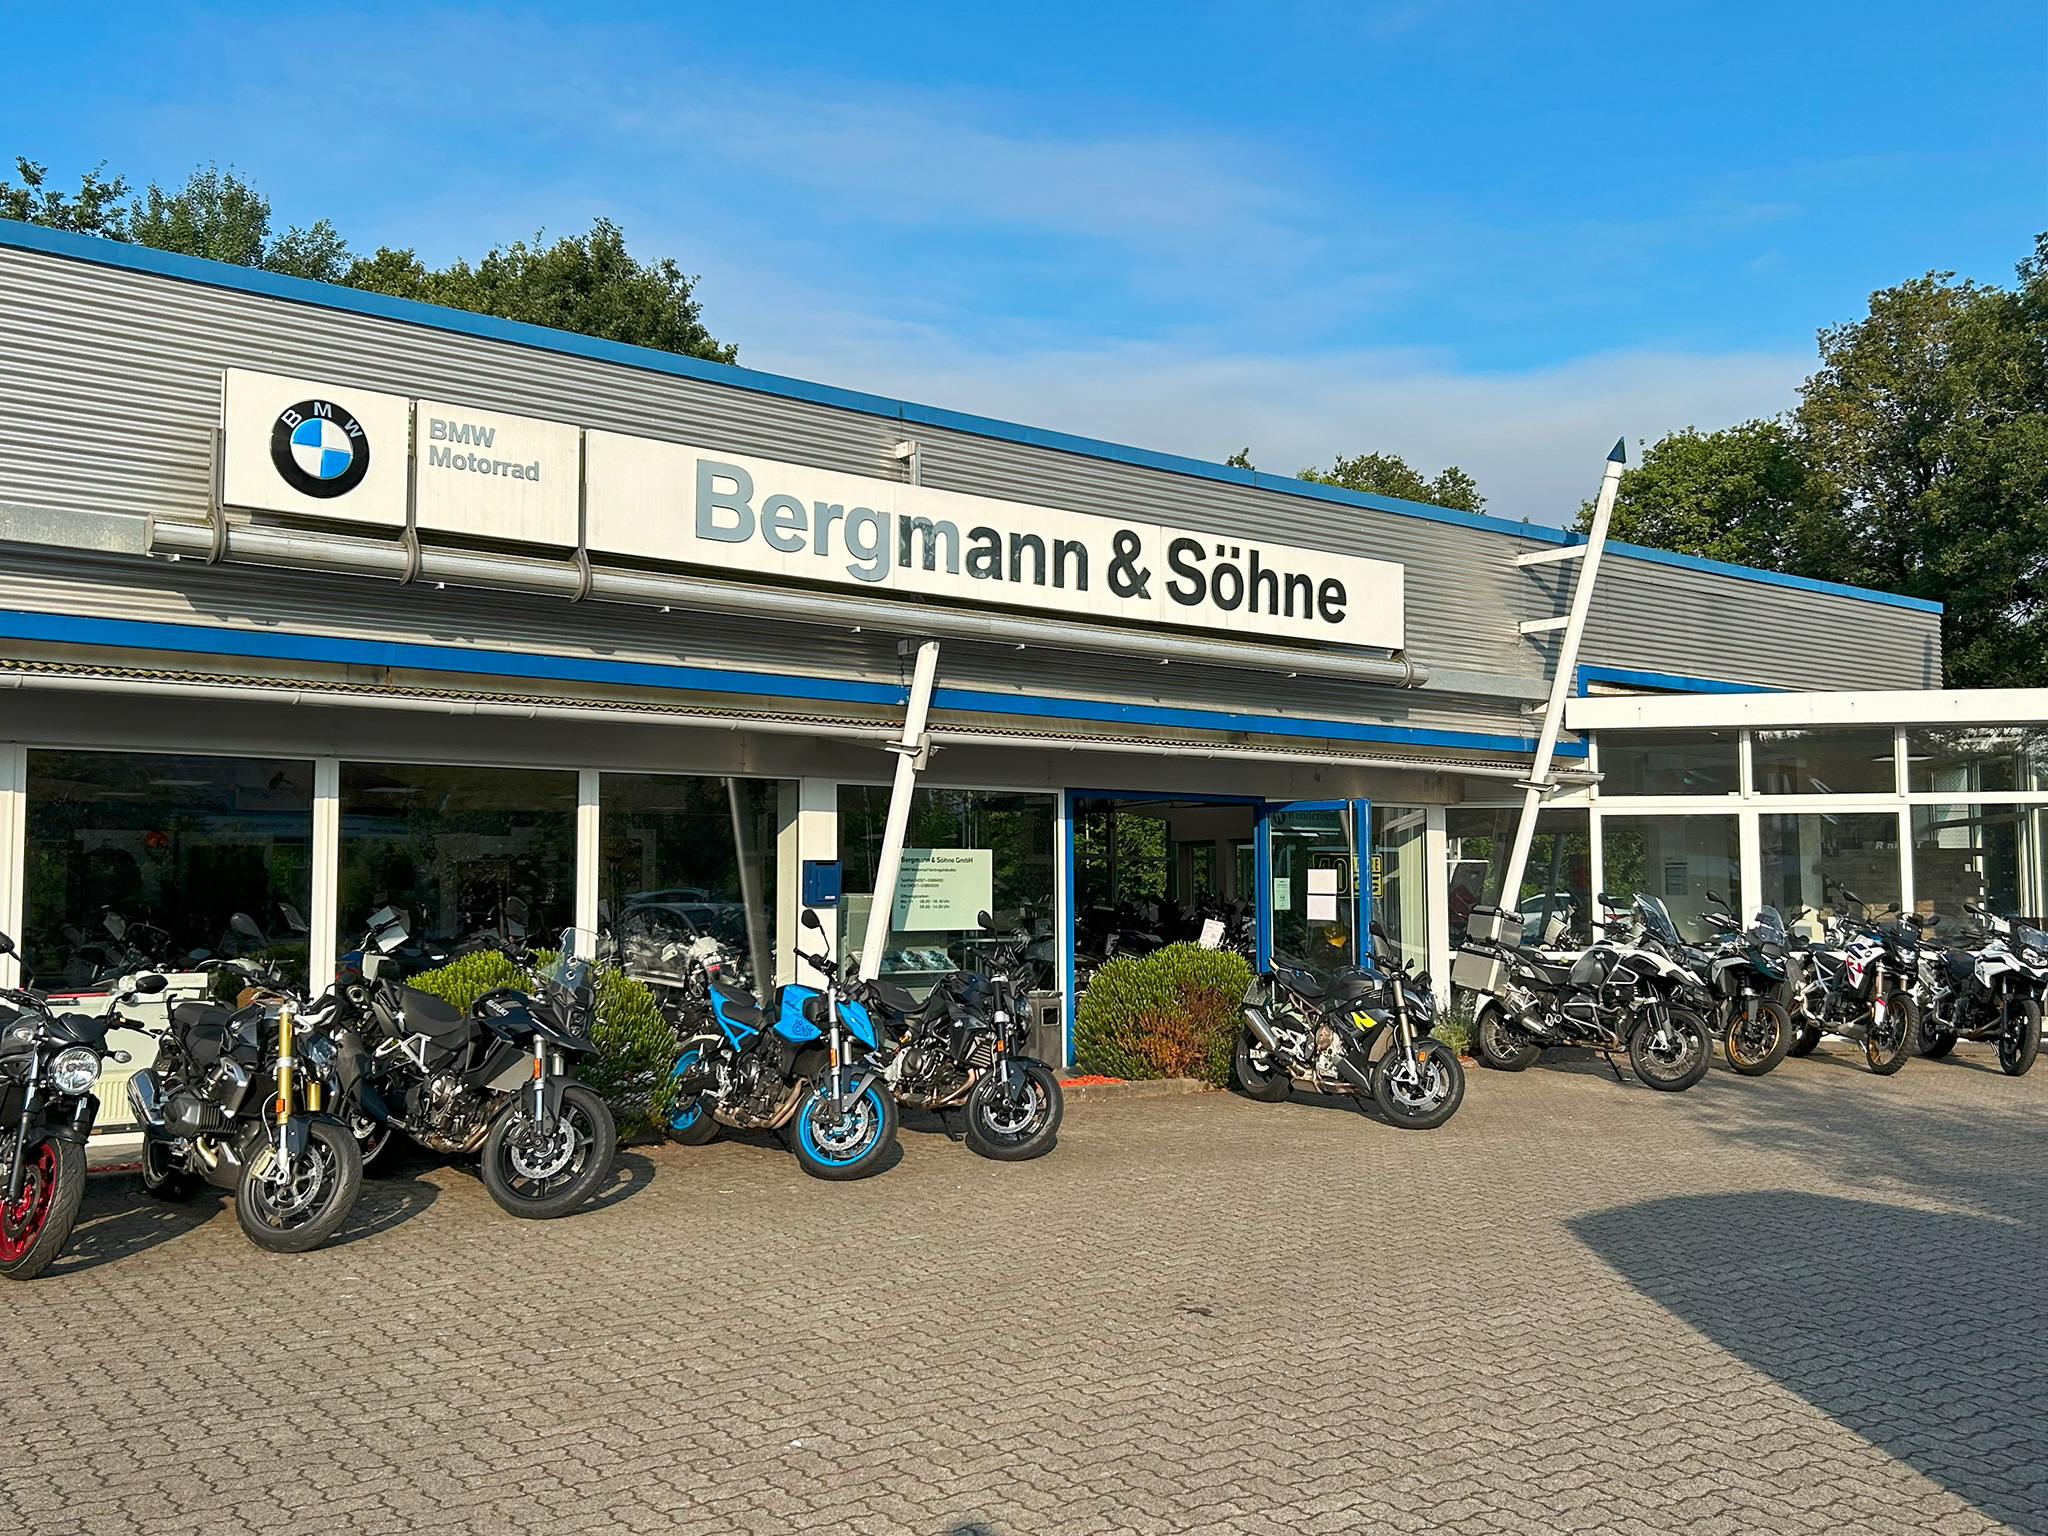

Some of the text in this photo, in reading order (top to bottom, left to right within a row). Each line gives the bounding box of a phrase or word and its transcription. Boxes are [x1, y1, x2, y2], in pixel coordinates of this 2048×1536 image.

[280, 401, 363, 438] BMW
[429, 418, 496, 449] BMW
[428, 444, 541, 482] Motorrad
[695, 458, 1348, 624] Bergmann & Söhne
[900, 856, 931, 864] Bergmann
